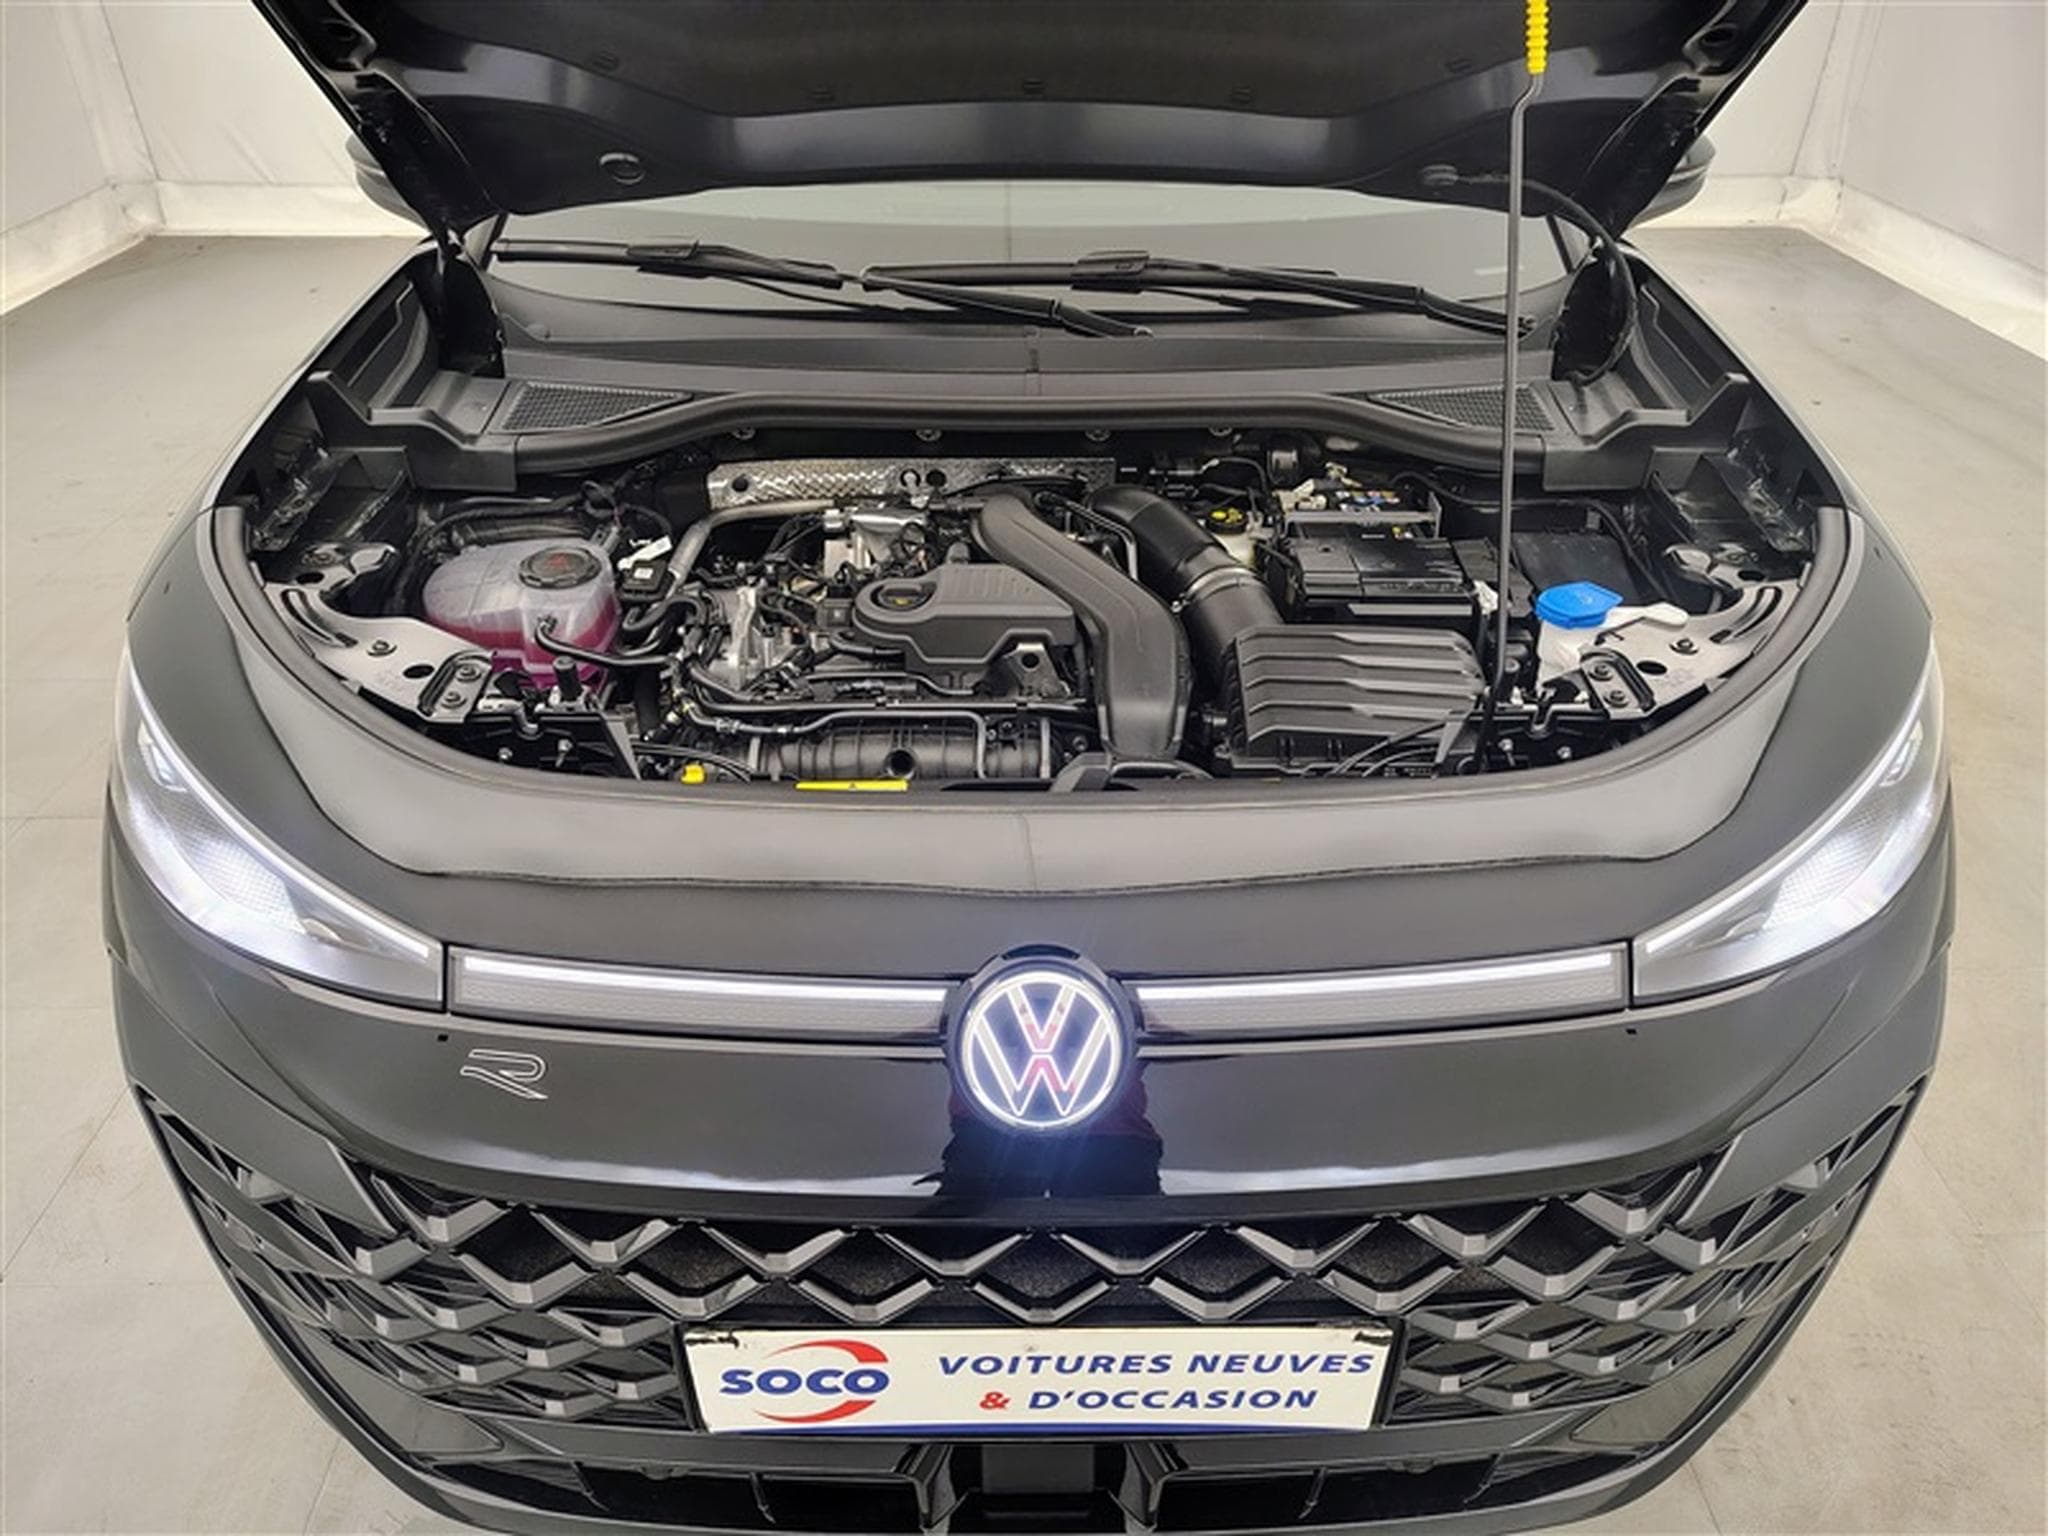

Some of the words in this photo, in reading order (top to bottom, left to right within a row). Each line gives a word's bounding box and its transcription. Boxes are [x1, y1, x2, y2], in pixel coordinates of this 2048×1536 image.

[939, 1355, 1173, 1375] VOITURES
[1187, 1354, 1374, 1374] NEUVES
[719, 1368, 889, 1395] SOCO
[979, 1391, 1010, 1409] &
[1028, 1390, 1318, 1409] D'OCCASION
